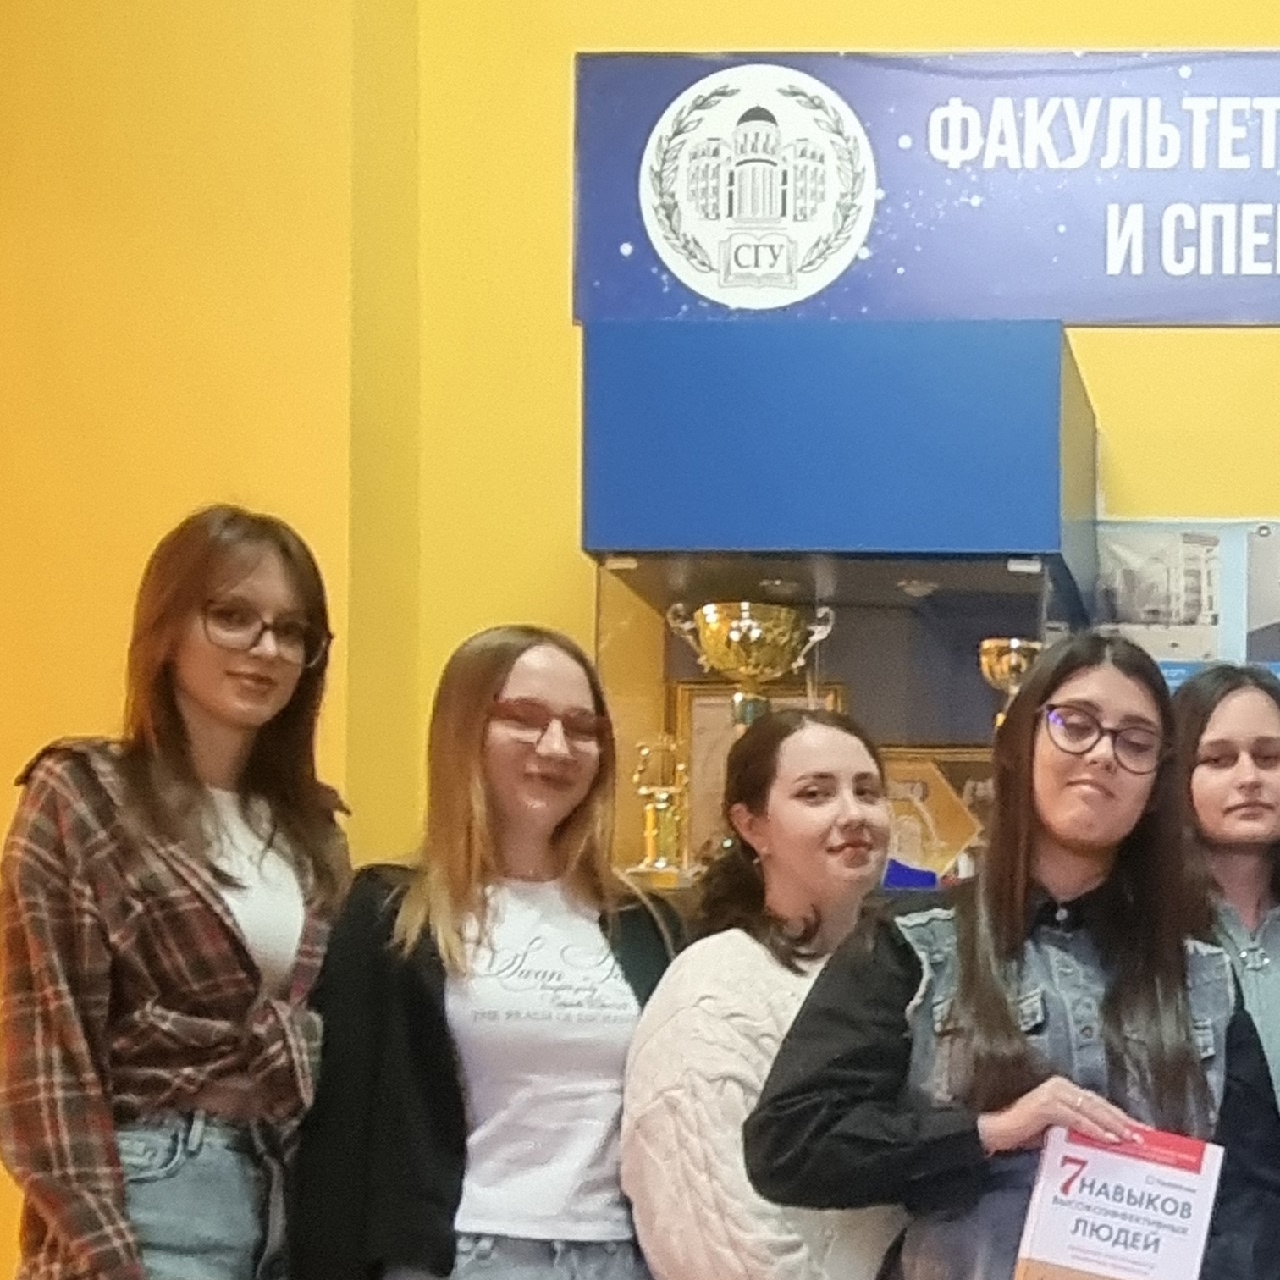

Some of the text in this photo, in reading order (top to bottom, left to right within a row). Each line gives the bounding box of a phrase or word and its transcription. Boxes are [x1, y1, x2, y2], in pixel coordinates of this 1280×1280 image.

[733, 243, 785, 269] СГУ
[1106, 202, 1144, 275] И
[1058, 1155, 1088, 1197] 7
[1078, 1178, 1194, 1220] НАВЫКОВ
[1070, 1217, 1162, 1255] ЛЮДЕЙ
